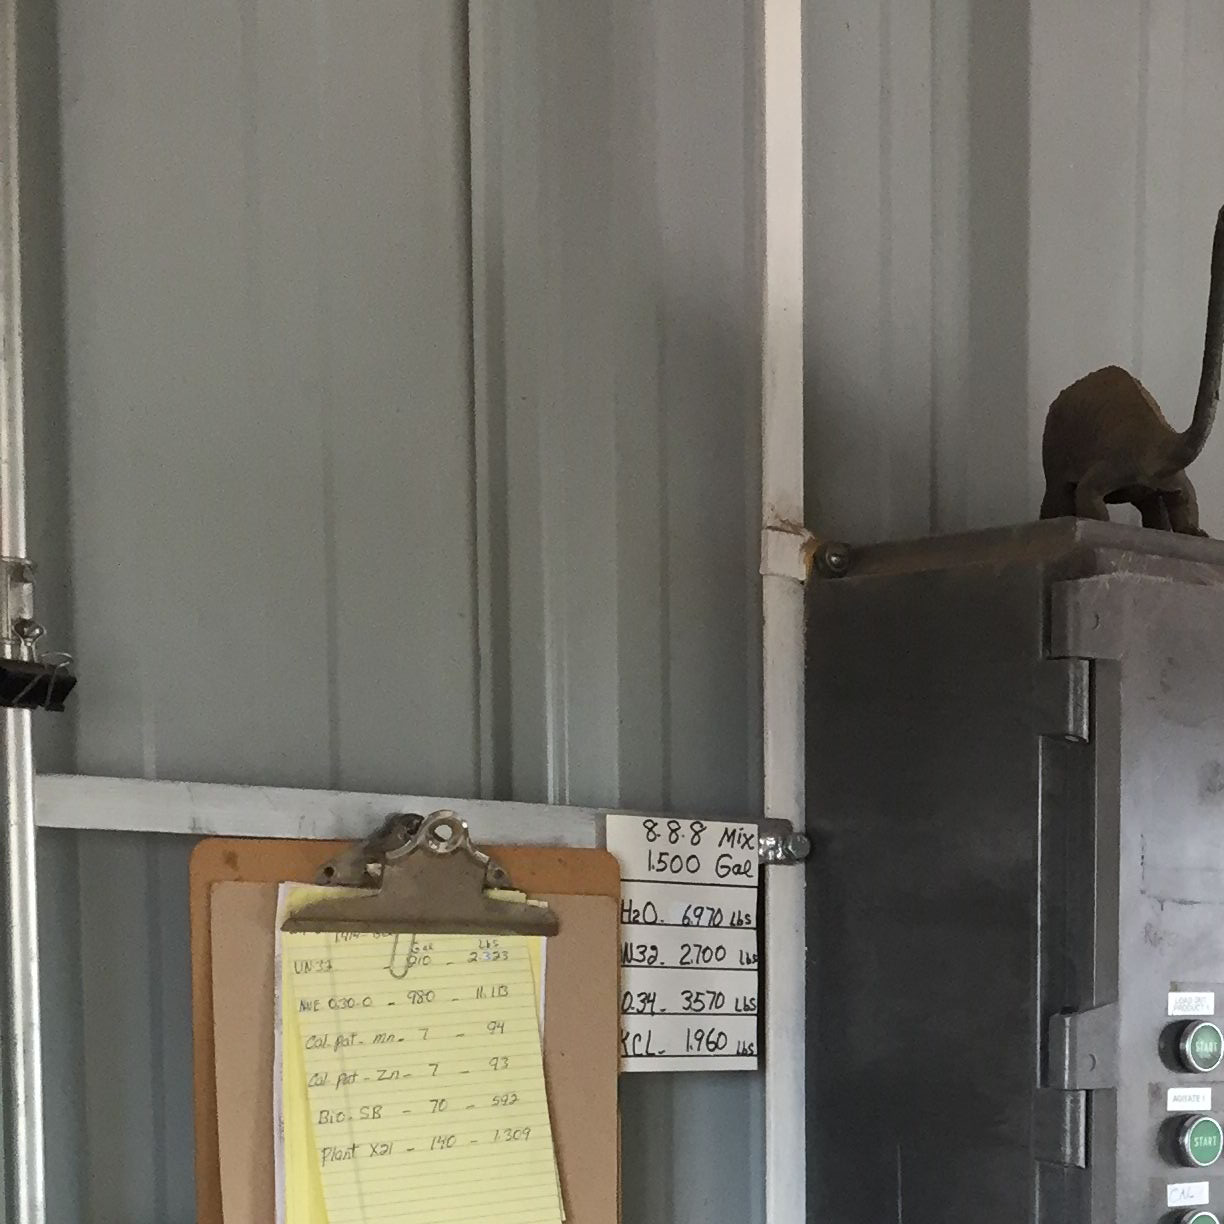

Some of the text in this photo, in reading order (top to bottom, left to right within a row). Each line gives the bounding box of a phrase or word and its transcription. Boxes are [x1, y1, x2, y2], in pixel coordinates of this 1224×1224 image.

[718, 827, 755, 850] Mix
[715, 853, 754, 878] Gal
[406, 990, 436, 1005] 980
[420, 1020, 506, 1041] 7 94
[1195, 1041, 1218, 1054] START
[429, 1063, 439, 1077] 7
[488, 1056, 510, 1070] 93
[359, 1104, 383, 1120] SB
[429, 1098, 449, 1113] 70
[491, 1093, 520, 1106] 592
[430, 1134, 458, 1151] 140
[1194, 1136, 1217, 1148] START
